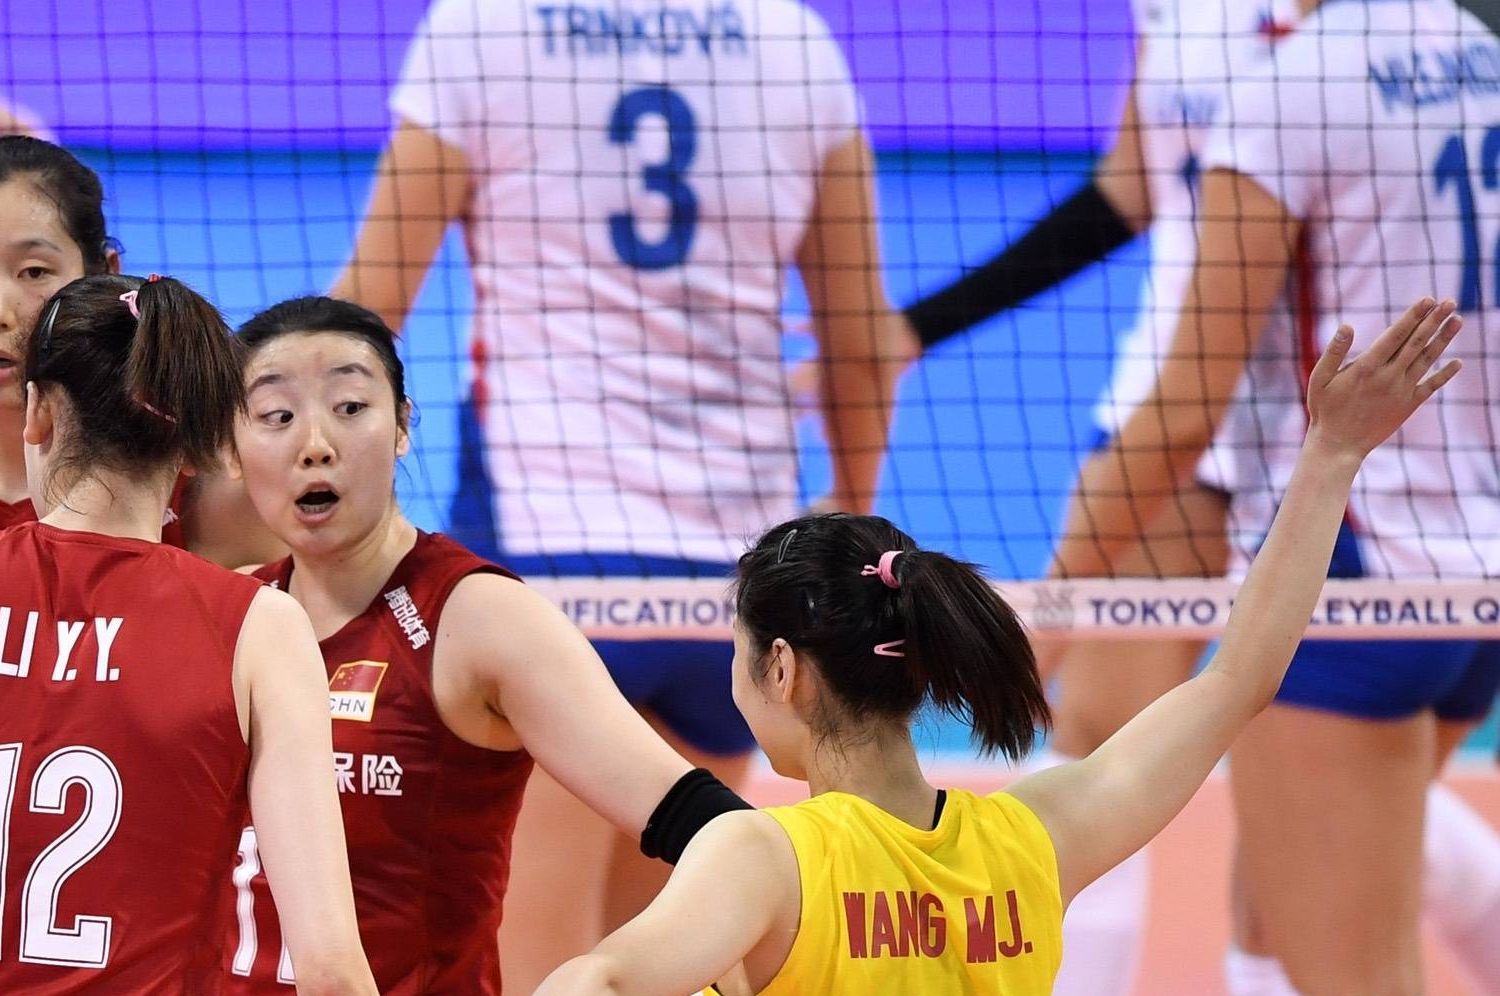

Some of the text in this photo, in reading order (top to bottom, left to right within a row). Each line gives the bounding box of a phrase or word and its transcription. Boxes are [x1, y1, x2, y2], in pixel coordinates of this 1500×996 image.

[606, 84, 700, 273] 3
[1090, 598, 1217, 626] TOKYO
[842, 889, 1034, 964] WANG MJ.
